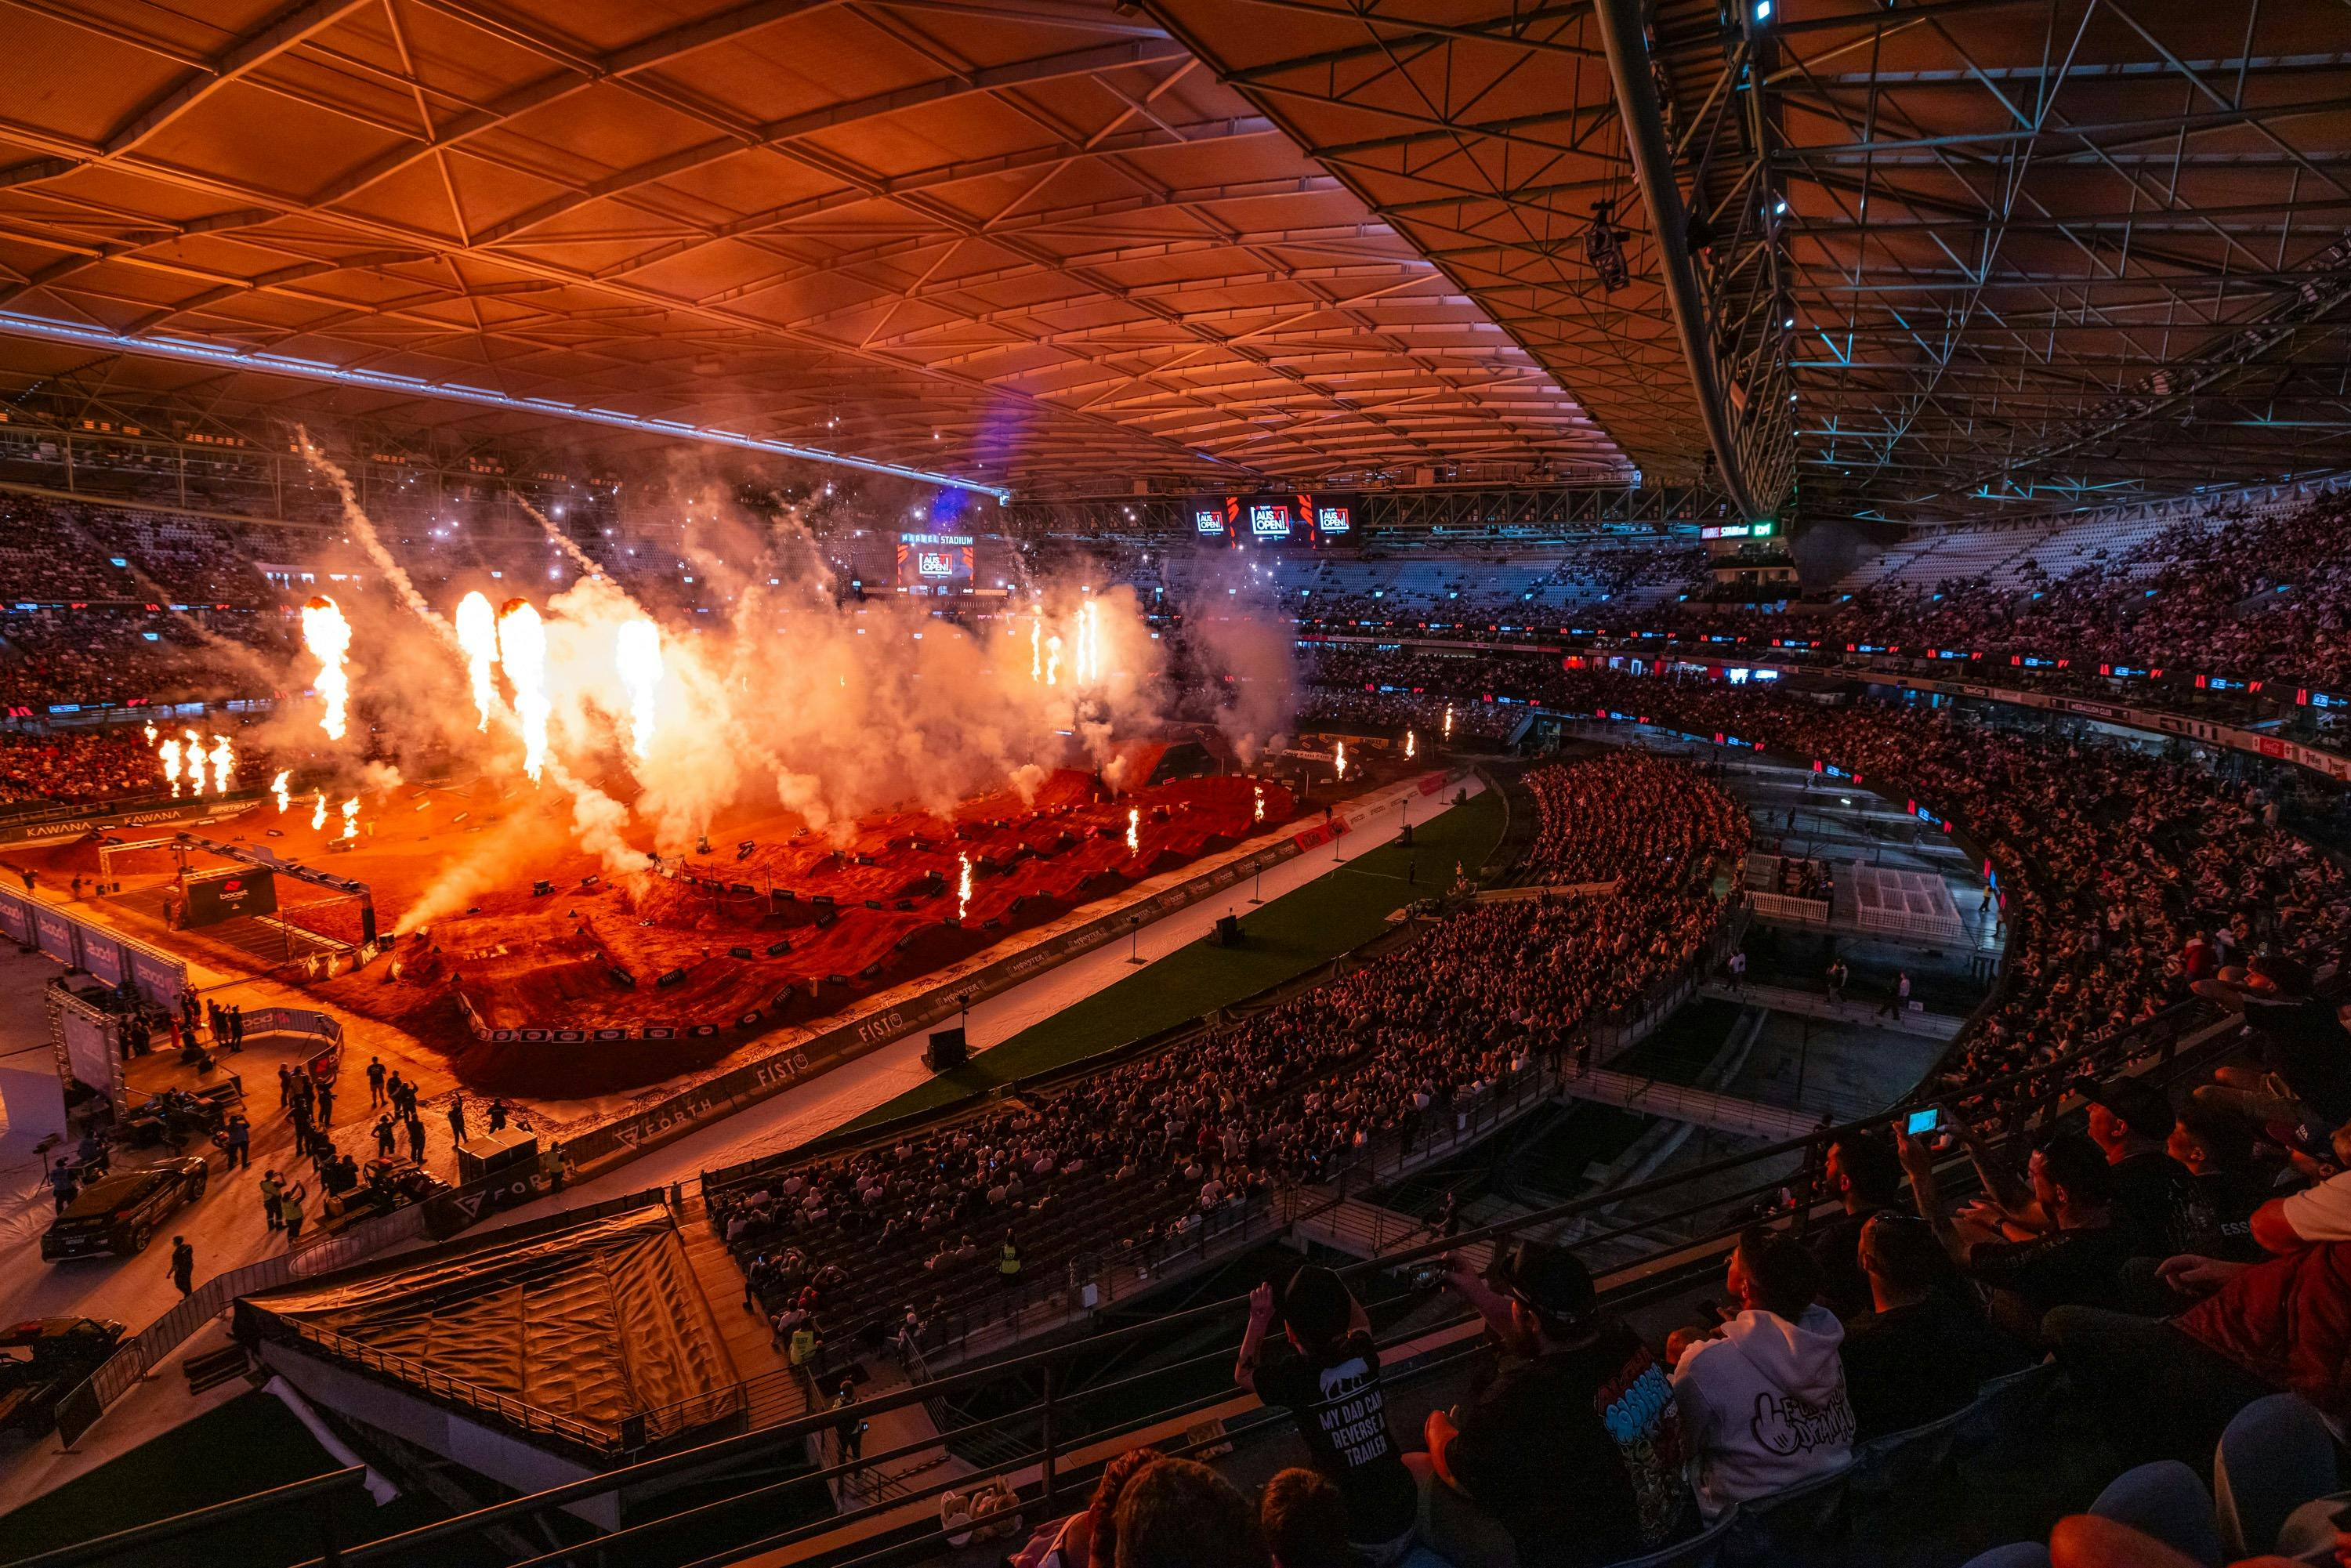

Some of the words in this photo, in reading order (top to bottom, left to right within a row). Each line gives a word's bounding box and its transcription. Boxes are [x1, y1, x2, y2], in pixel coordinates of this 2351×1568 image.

[1255, 509, 1281, 520] AUSX
[1256, 520, 1282, 530] OPEN
[902, 533, 940, 544] MARVEL
[940, 535, 973, 545] STADIUM
[2071, 703, 2099, 715] MEDALLION
[2099, 708, 2112, 716] CLUB
[124, 810, 181, 824] KAWANA
[27, 822, 91, 837] KAWANA
[219, 889, 248, 900] boost
[1170, 892, 1186, 902] boost
[1074, 929, 1101, 945] MONSTER
[1013, 953, 1044, 972] MONSTER
[944, 983, 980, 1004] MONSTER
[858, 1017, 892, 1042] FIST
[756, 1058, 796, 1088] FIST
[645, 1098, 712, 1137] FORTH
[1319, 1408, 1340, 1431] MY
[1341, 1400, 1364, 1423] DAD
[1364, 1390, 1383, 1410] CAN
[1331, 1416, 1379, 1449] REVERSE
[1378, 1412, 1386, 1430] A
[1344, 1434, 1387, 1468] TRAILER
